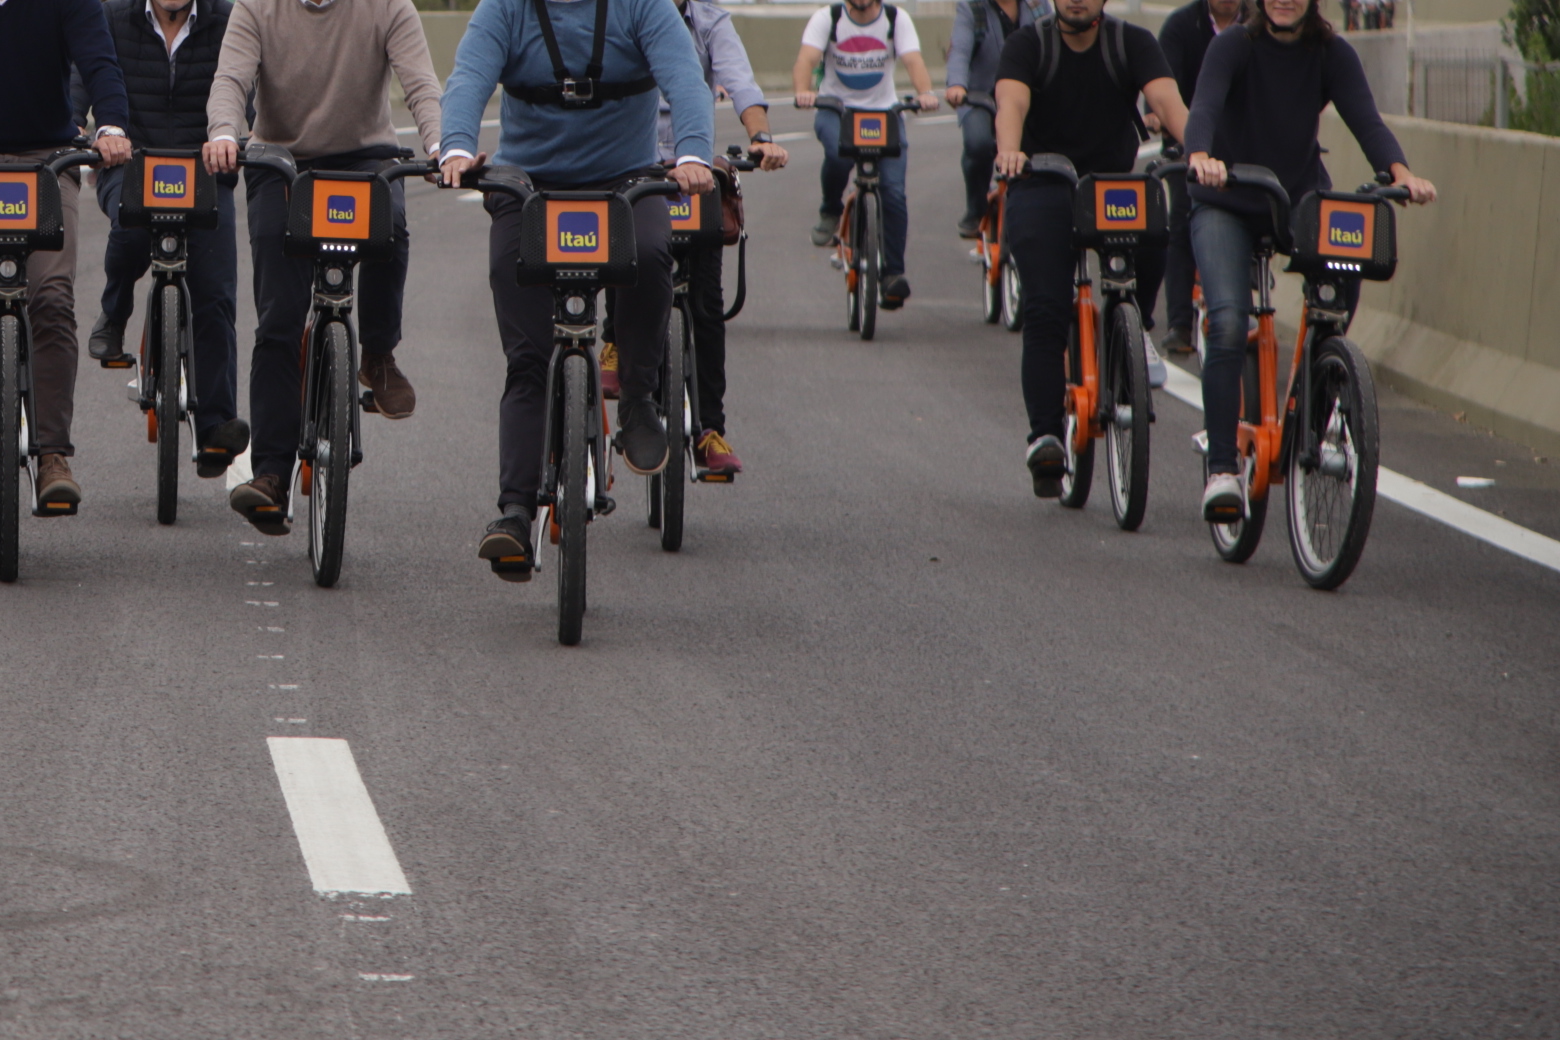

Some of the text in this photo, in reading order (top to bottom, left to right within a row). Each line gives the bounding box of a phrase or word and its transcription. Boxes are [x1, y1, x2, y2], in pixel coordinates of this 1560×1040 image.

[860, 125, 881, 138] Itaú
[154, 178, 185, 195] Itaú
[328, 206, 354, 220] Itaú
[669, 203, 690, 216] aú
[1106, 202, 1136, 219] Itaú
[560, 228, 597, 248] Itaú
[1330, 226, 1363, 244] Itaú
